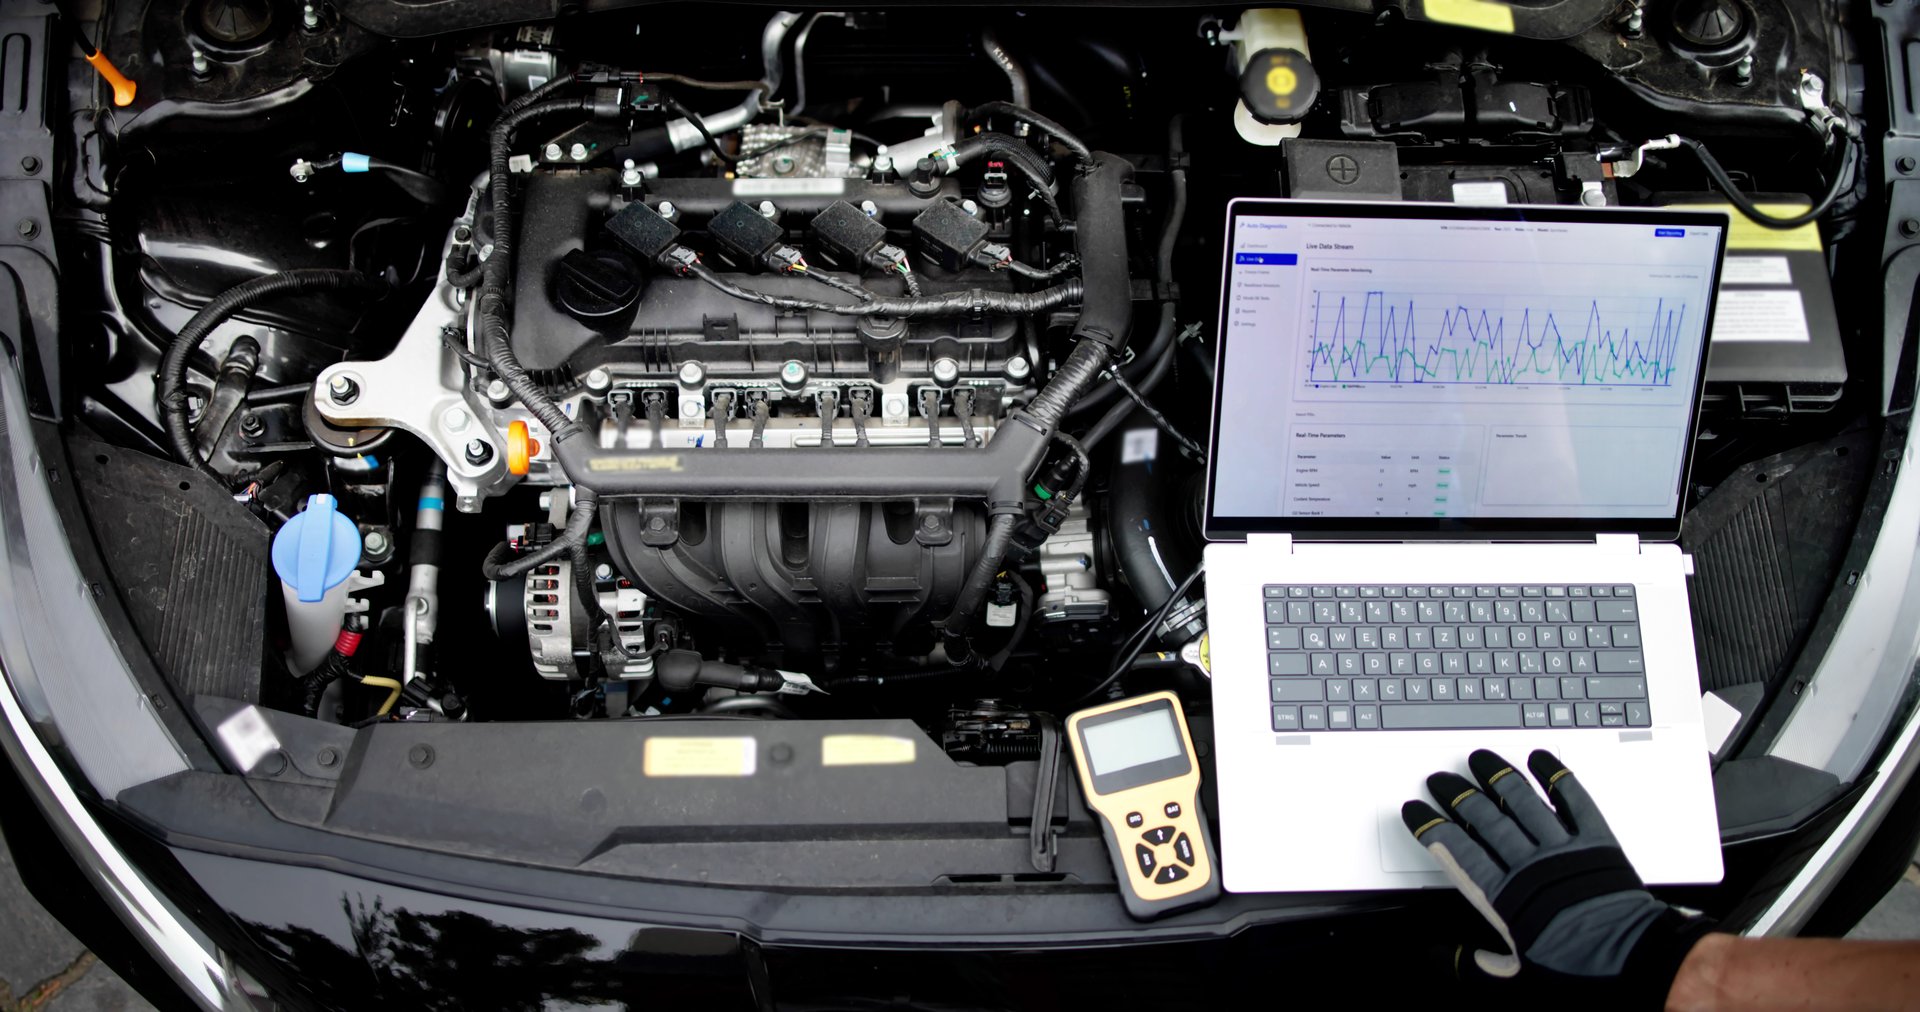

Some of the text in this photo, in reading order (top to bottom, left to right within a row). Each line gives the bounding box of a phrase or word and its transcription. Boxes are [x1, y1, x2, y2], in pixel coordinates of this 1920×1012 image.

[1322, 607, 1328, 616] 2
[1349, 607, 1355, 616] 3
[1374, 607, 1381, 616] 4
[1400, 607, 1407, 616] 5
[1426, 607, 1433, 616] 6
[1452, 607, 1458, 615] 7
[1477, 607, 1484, 616] 8
[1503, 607, 1510, 615] 9
[1528, 607, 1536, 616] 0
[1309, 633, 1319, 642] Q
[1334, 633, 1346, 642] W
[1363, 633, 1370, 642] E
[1388, 633, 1396, 642] R
[1415, 632, 1422, 641] T
[1441, 632, 1448, 642] Z
[1466, 633, 1475, 642] U
[1517, 632, 1526, 641] O
[1543, 632, 1551, 641] P
[1319, 659, 1327, 668] A
[1345, 658, 1353, 668] S
[1371, 659, 1379, 668] D
[1398, 658, 1404, 668] F
[1423, 658, 1432, 668] G
[1449, 658, 1458, 667] H
[1477, 658, 1483, 668] J
[1501, 658, 1509, 667] K
[1527, 658, 1534, 667] L
[1334, 684, 1500, 694] Y X C V B N M
[1167, 805, 1179, 814] BAT
